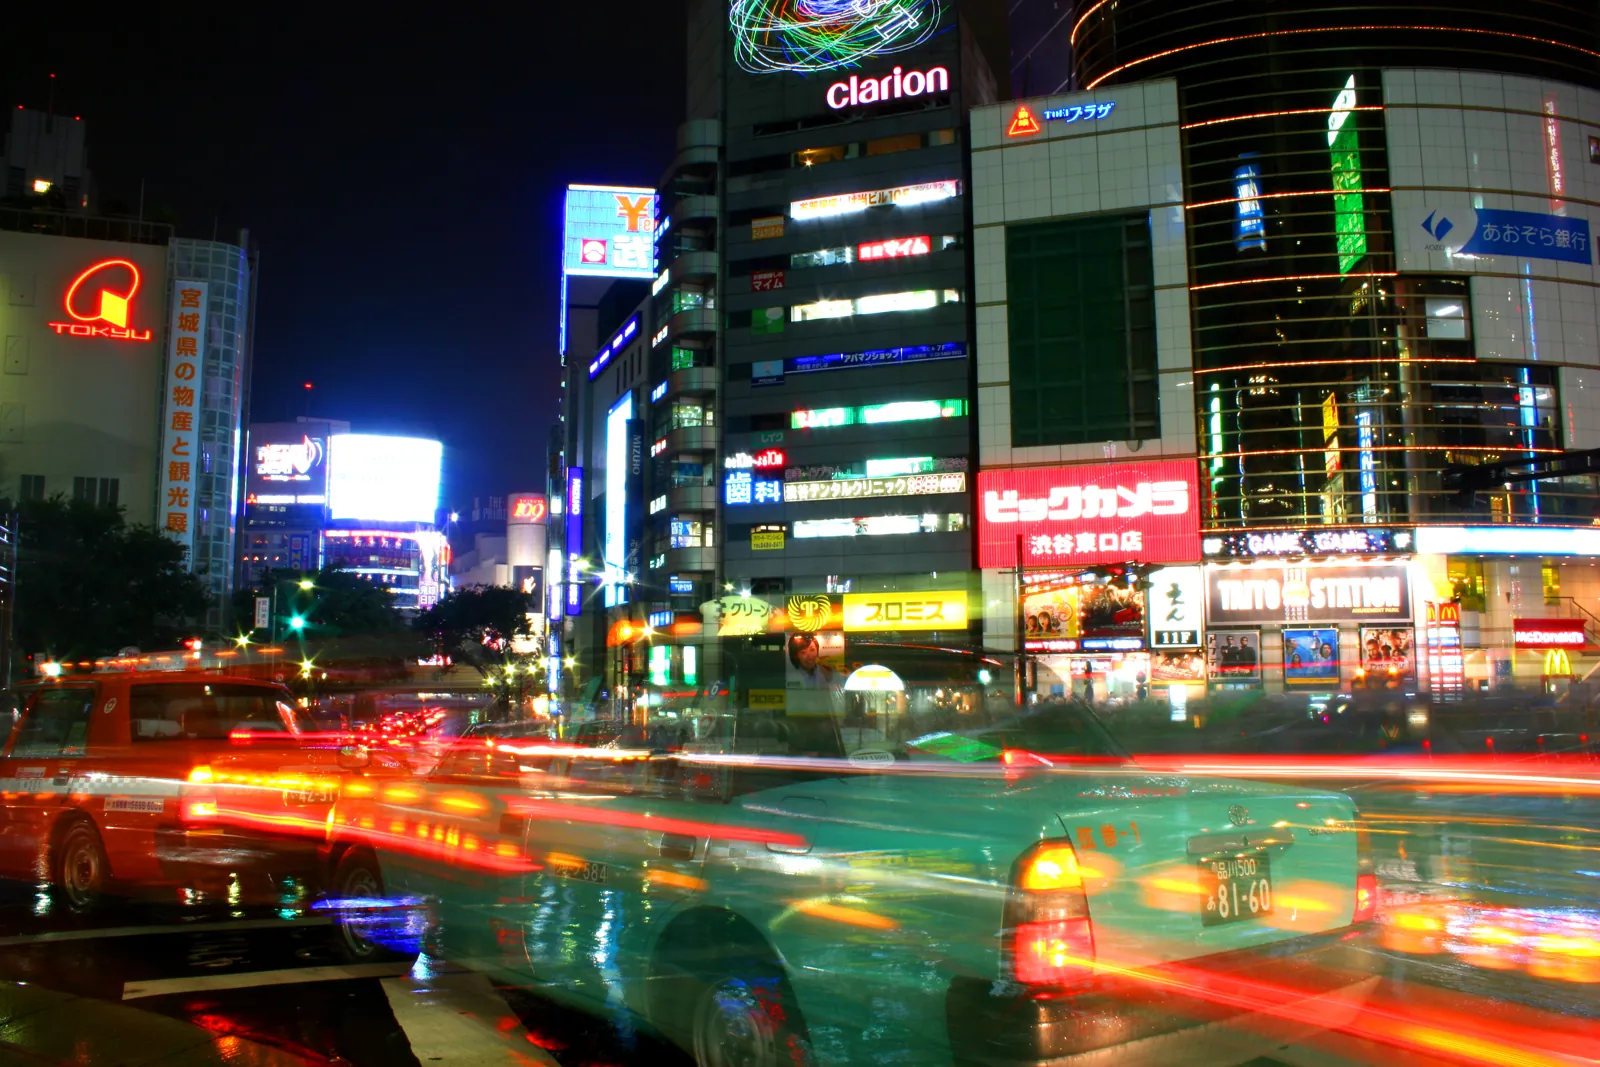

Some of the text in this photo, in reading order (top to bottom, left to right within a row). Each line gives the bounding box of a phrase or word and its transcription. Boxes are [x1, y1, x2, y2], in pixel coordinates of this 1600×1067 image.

[826, 66, 948, 109] clarion
[1482, 222, 1587, 250] あおぞら銀行
[752, 280, 783, 291] マイム
[48, 321, 151, 340] TOKYU
[843, 349, 899, 364] アパマンショップ
[166, 287, 202, 534] 宮城県の物産と観光展
[632, 434, 642, 476] MIZUHO
[571, 478, 581, 515] MIZUHO
[726, 472, 781, 504] 歯科
[984, 481, 1188, 523] ビックカメラ
[514, 500, 544, 521] 109
[1031, 532, 1142, 555] 渋谷東口店
[1248, 531, 1368, 554] GAME GAME
[1165, 582, 1185, 622] えん
[1309, 576, 1400, 609] STATION
[864, 600, 944, 622] プロミス
[1162, 631, 1192, 644] 11F
